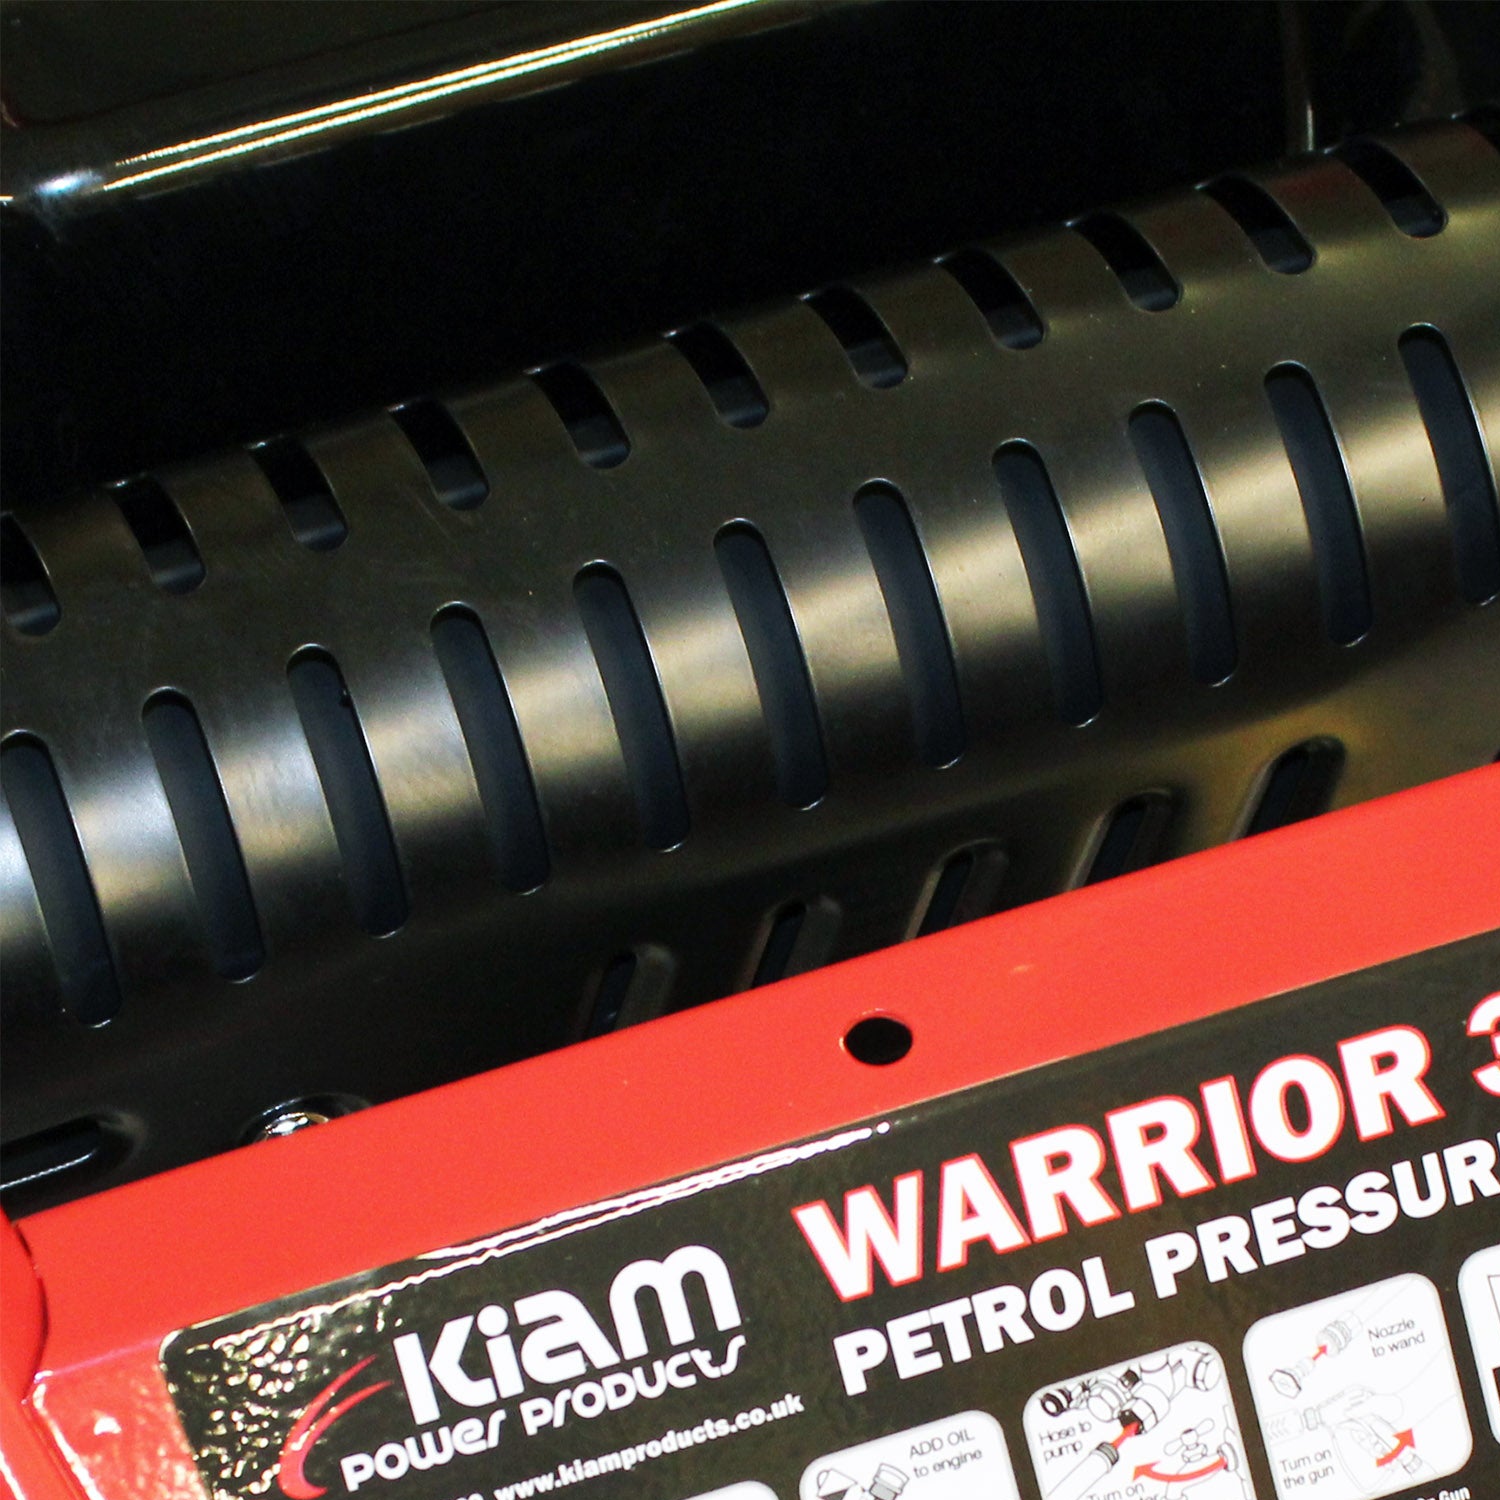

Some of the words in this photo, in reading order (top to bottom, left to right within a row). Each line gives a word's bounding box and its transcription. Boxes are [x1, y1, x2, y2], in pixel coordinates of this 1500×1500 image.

[792, 1026, 1445, 1302] WARRIOR
[832, 1255, 1135, 1396] PETROL
[909, 1436, 944, 1458] ADD
[946, 1428, 974, 1446] OIL
[912, 1466, 929, 1478] to
[932, 1449, 983, 1472] engine
[1124, 1477, 1145, 1498] on
